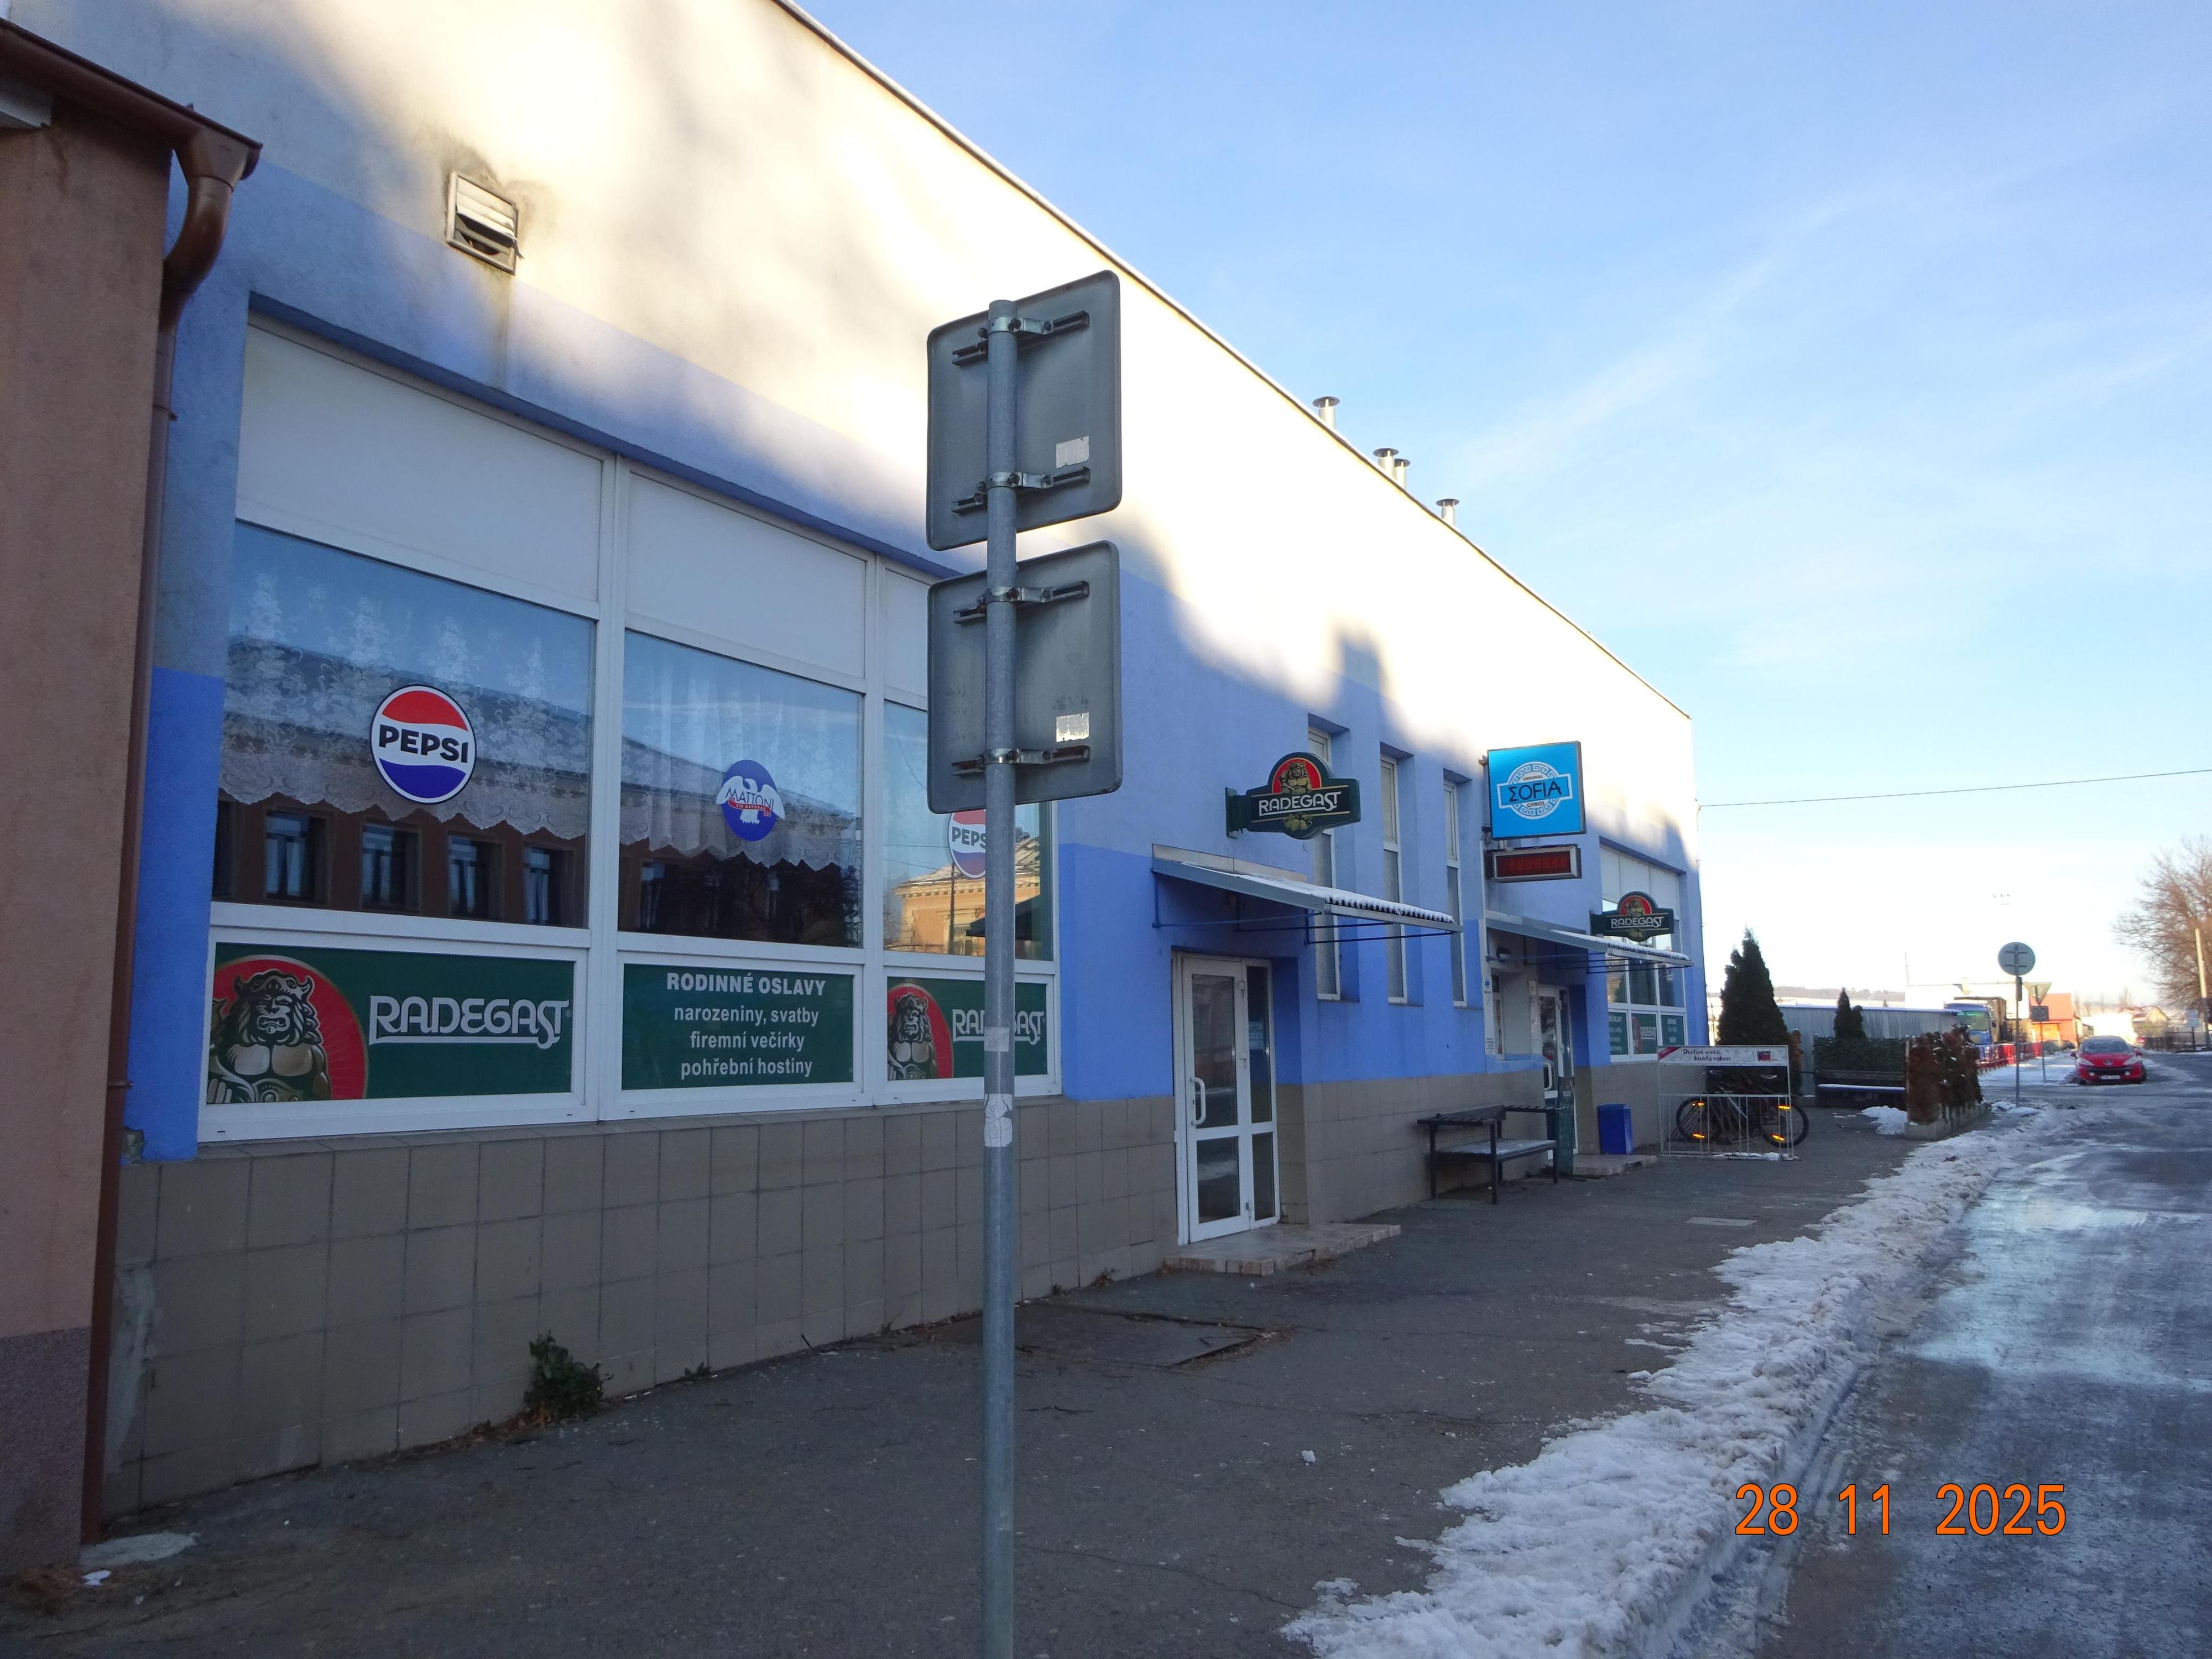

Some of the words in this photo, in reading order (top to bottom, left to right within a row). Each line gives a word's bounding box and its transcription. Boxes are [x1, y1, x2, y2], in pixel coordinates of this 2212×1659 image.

[379, 724, 468, 763] PEPSI
[726, 787, 774, 811] MATTONI
[1259, 791, 1342, 817] RADEGAST
[952, 826, 986, 848] PEPS
[1611, 916, 1664, 928] RADEGAST
[667, 972, 754, 993] RODINNÉ
[758, 977, 826, 996] OSLAVY
[369, 995, 570, 1049] RADEGAST
[674, 1005, 766, 1026] narozeniny,
[771, 1006, 819, 1027] svatby
[952, 1009, 1044, 1045] RAAST
[690, 1031, 747, 1048] firemní
[750, 1031, 805, 1052] večírky
[681, 1057, 753, 1080] pohřební
[758, 1057, 812, 1077] hostiny
